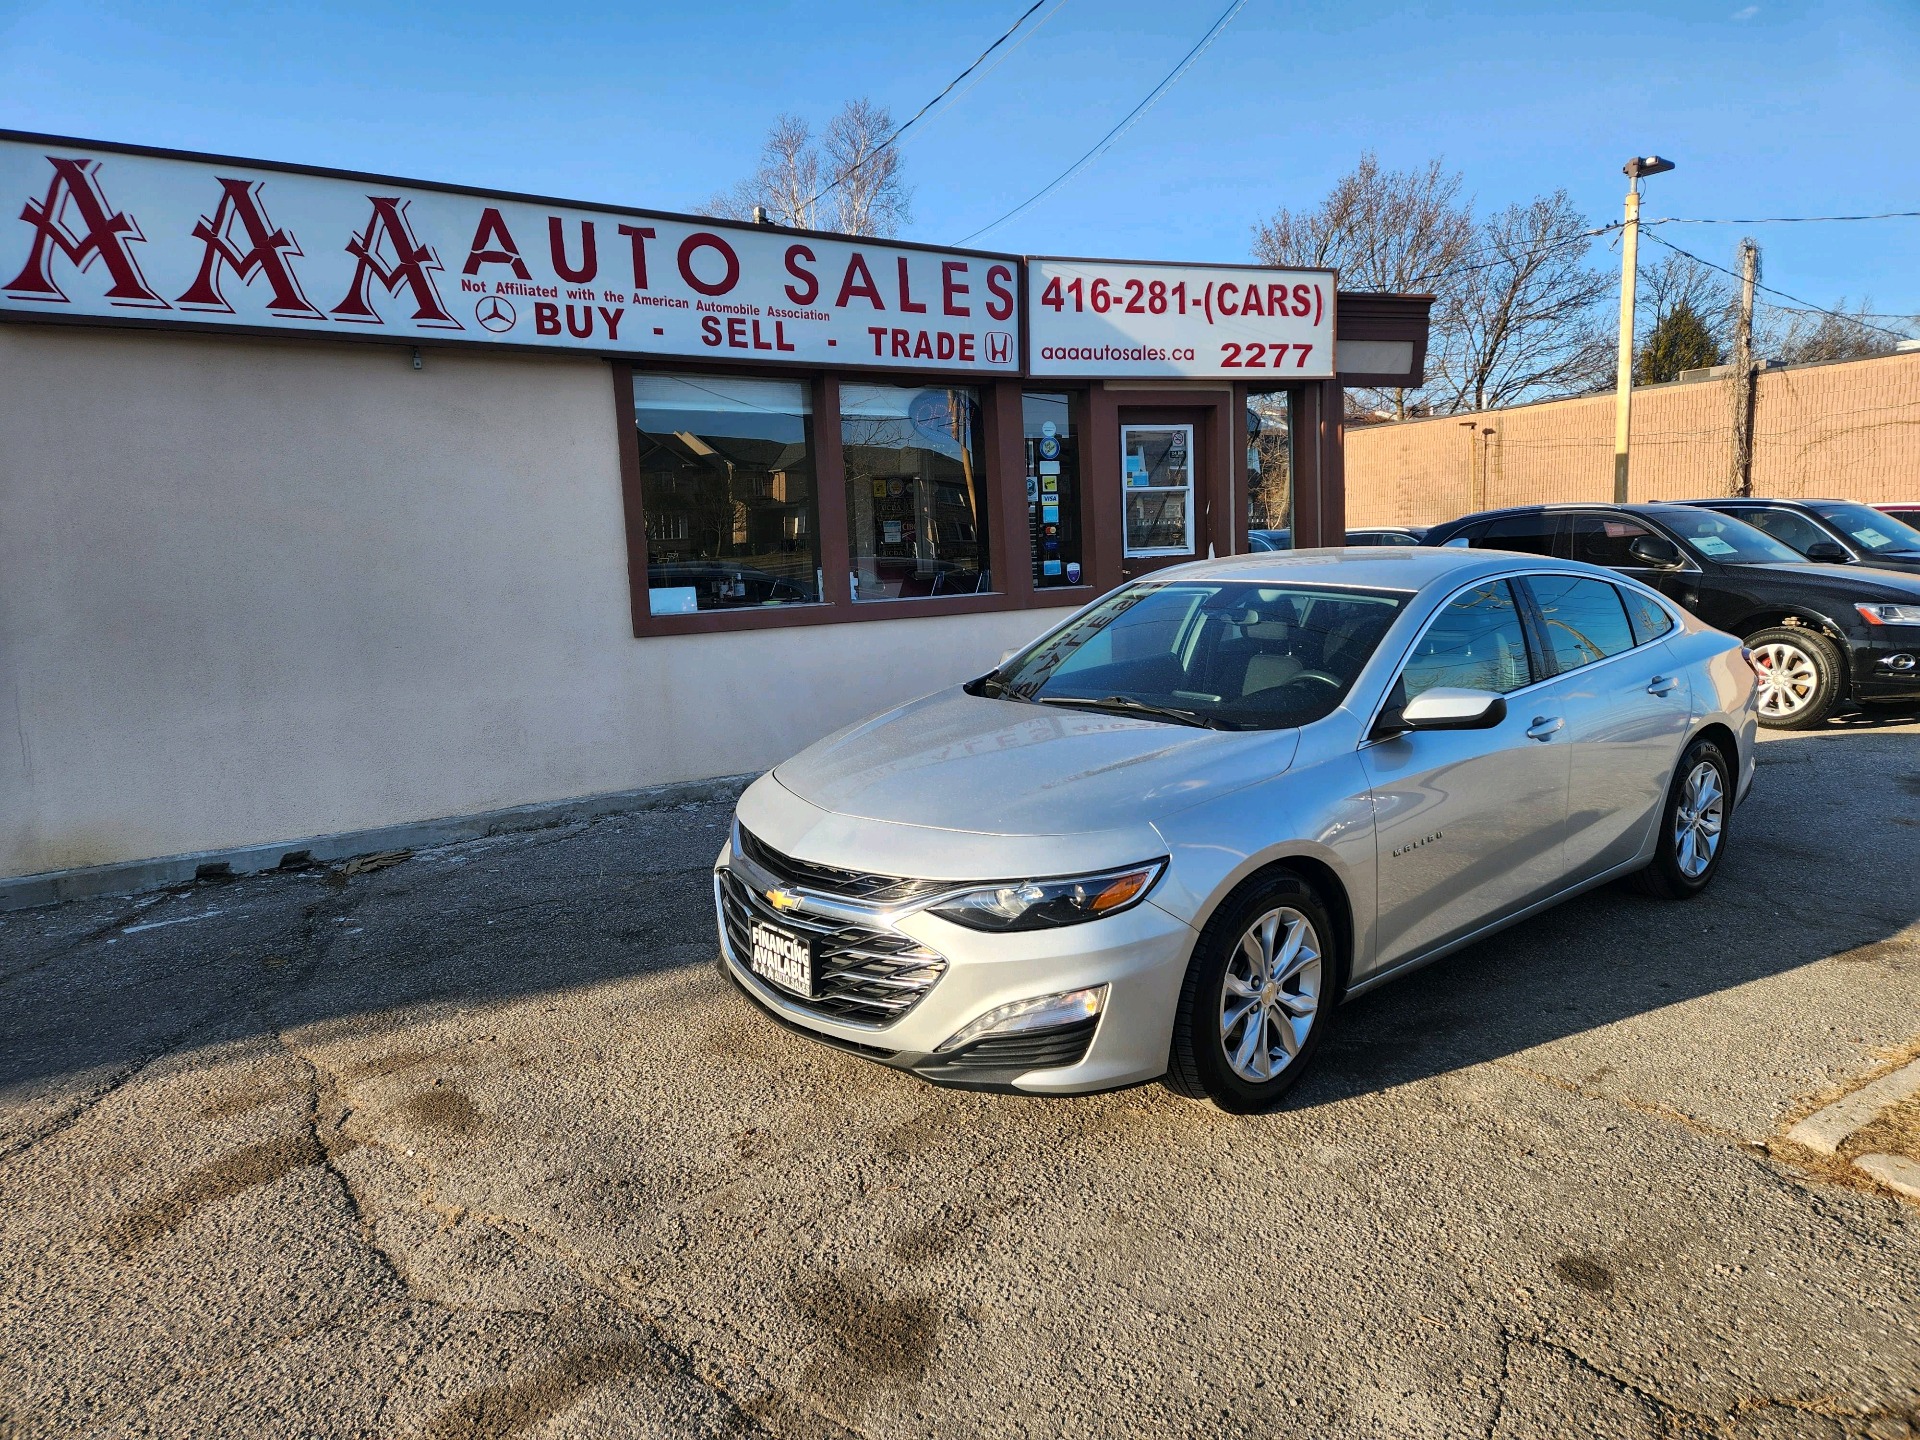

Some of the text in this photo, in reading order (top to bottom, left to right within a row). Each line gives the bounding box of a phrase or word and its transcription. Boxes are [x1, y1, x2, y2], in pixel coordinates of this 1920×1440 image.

[462, 207, 740, 297] AUTO
[784, 244, 1014, 321] SALES
[461, 278, 831, 322] Not Affiliated with the American Automobile Association
[1041, 276, 1323, 327] 416-281-(CARS)
[534, 302, 625, 341] BUY
[701, 315, 795, 352] SELL
[868, 326, 975, 362] TRADE
[1041, 344, 1195, 361] aaaautosales.ca
[1220, 342, 1313, 368] 2277
[1393, 831, 1443, 857] MALIBU
[752, 926, 809, 967] FINANCING
[754, 944, 810, 985] AVAILABLE
